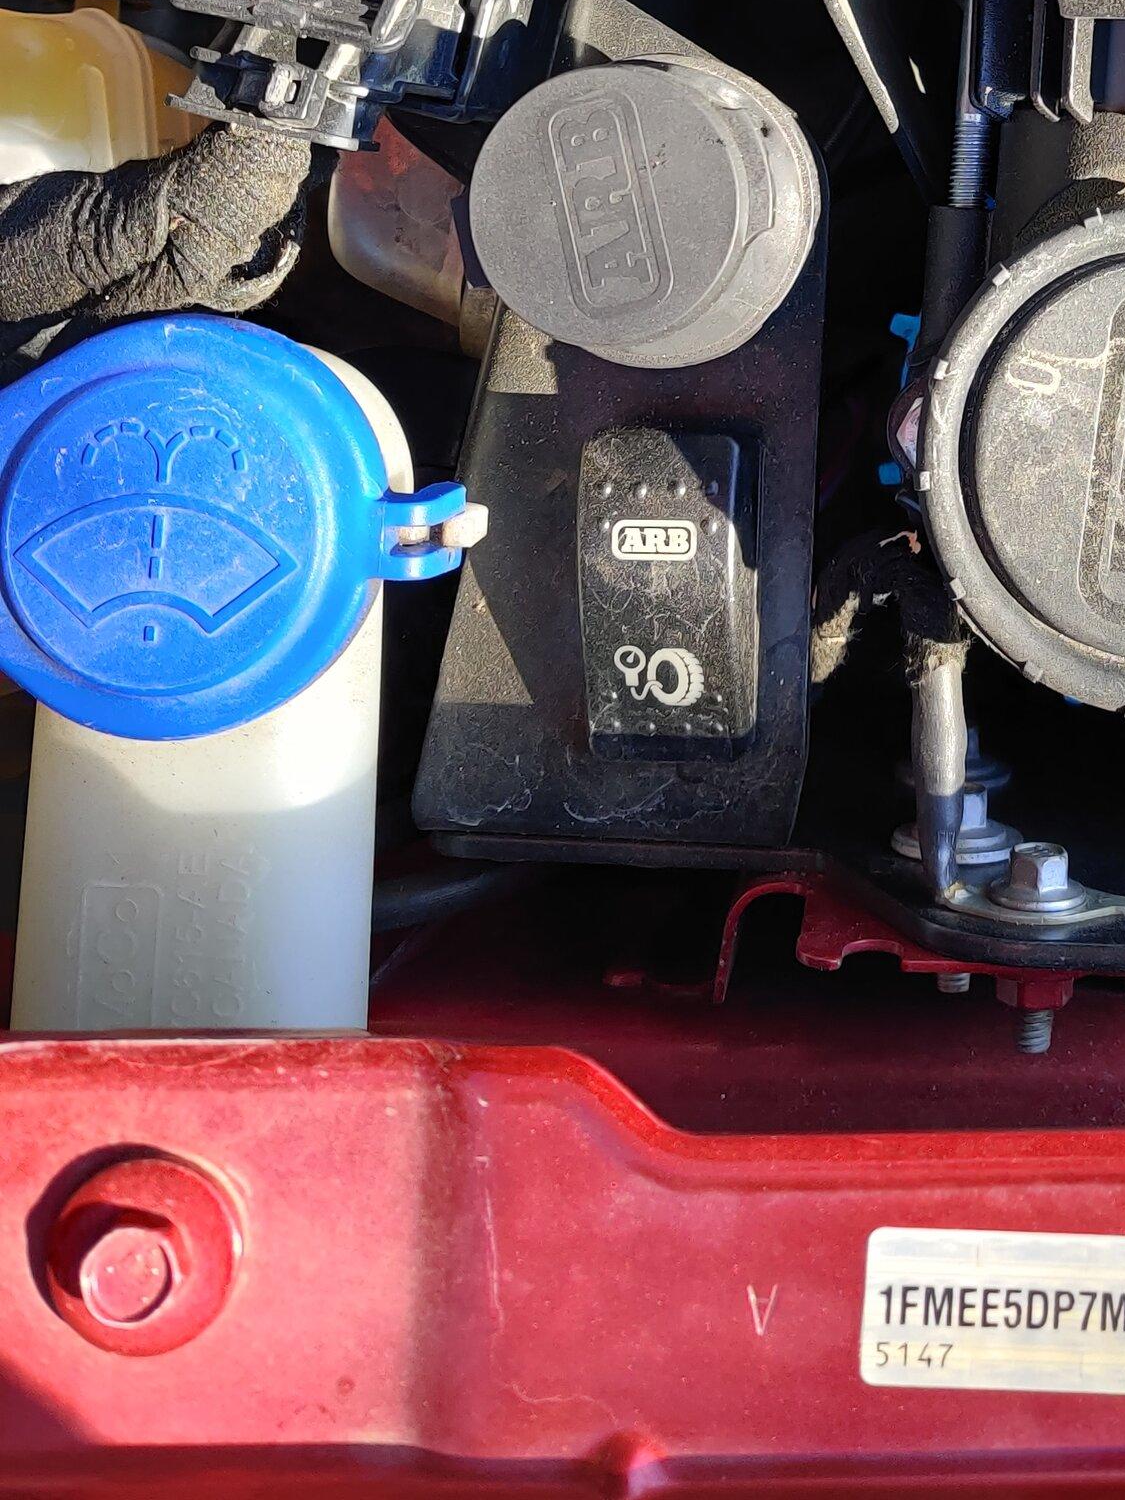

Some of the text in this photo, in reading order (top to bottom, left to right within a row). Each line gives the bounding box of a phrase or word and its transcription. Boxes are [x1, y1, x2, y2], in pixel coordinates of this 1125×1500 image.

[561, 106, 654, 291] ARB
[618, 526, 690, 555] ARB
[875, 1340, 954, 1370] 5147
